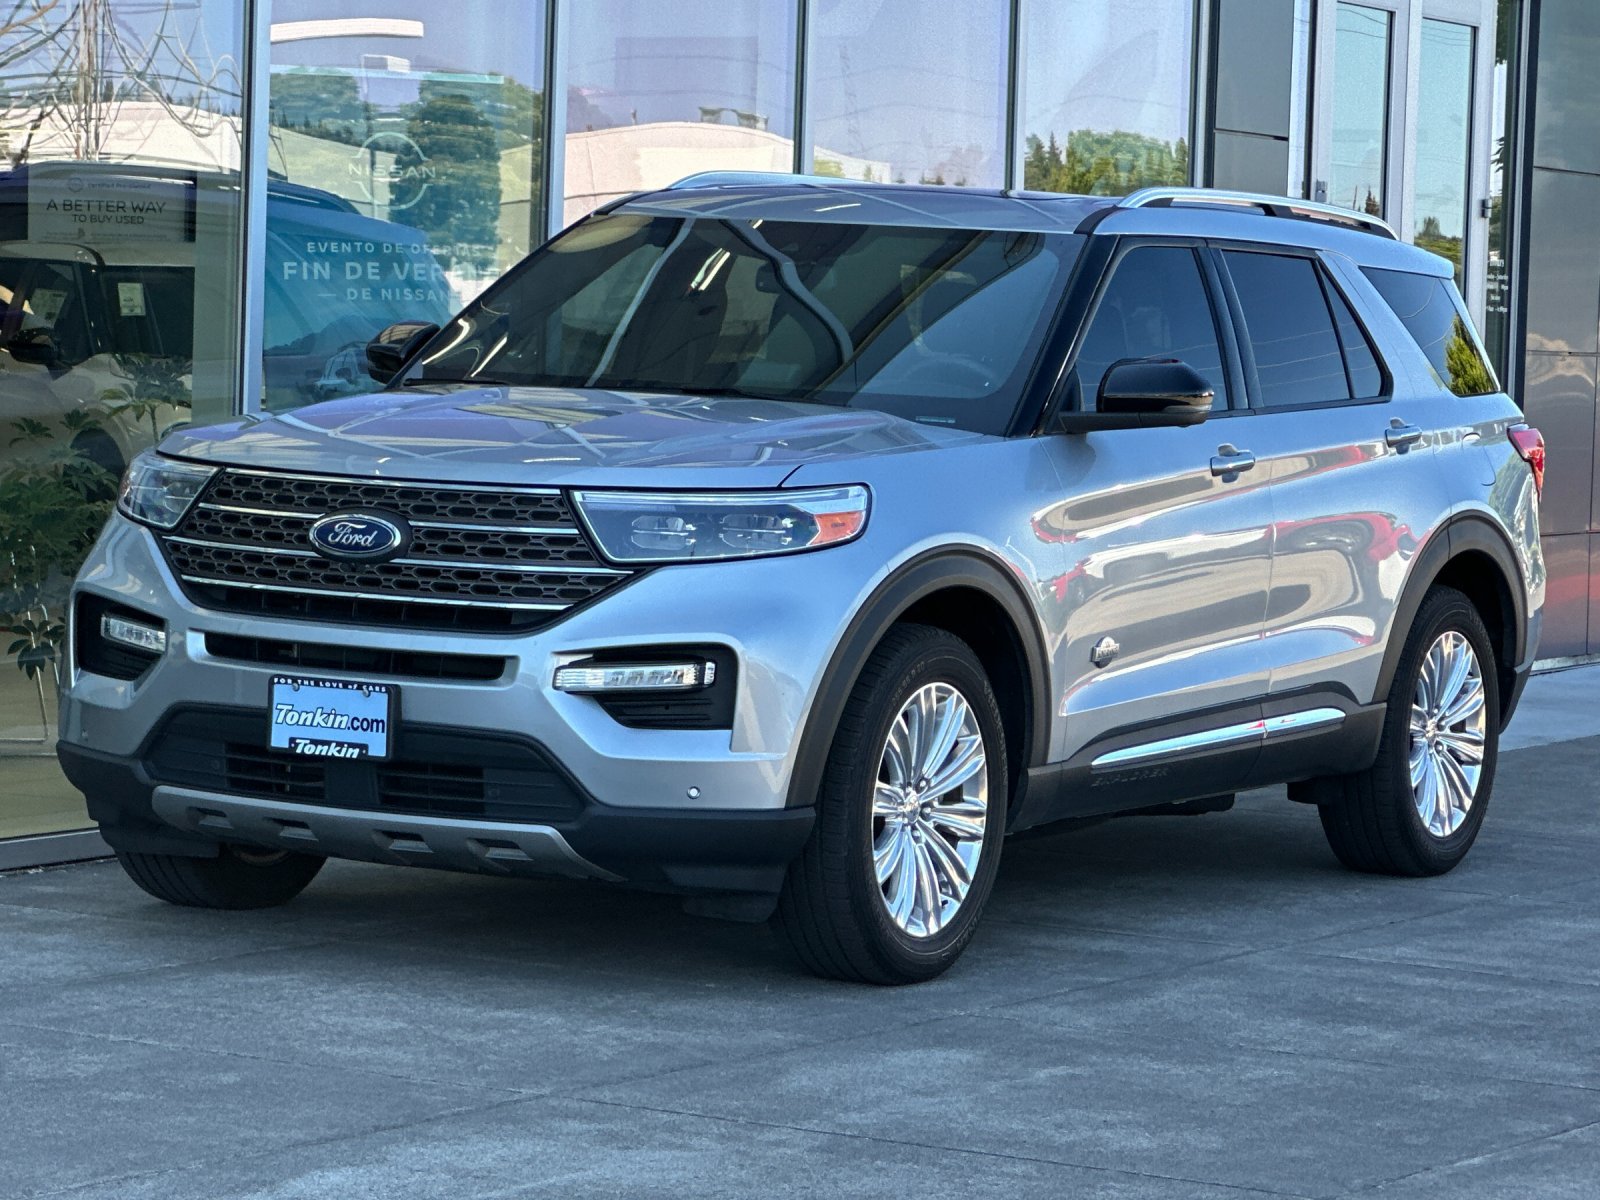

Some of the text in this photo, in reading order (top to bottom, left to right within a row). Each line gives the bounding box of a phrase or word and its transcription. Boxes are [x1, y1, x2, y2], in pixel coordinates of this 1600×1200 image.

[348, 163, 436, 178] NISSAN
[46, 199, 166, 213] A BETTER WAY
[73, 214, 145, 225] TO BUY USED
[307, 242, 481, 257] EVENTO DE OFERTAS
[283, 262, 331, 281] FIN
[345, 262, 380, 281] DE
[347, 288, 371, 301] DE
[327, 520, 376, 548] Ford
[273, 677, 293, 685] FOR
[320, 680, 344, 689] LOVE
[275, 703, 386, 734] Tonkin.com
[295, 738, 360, 759] Tonkin
